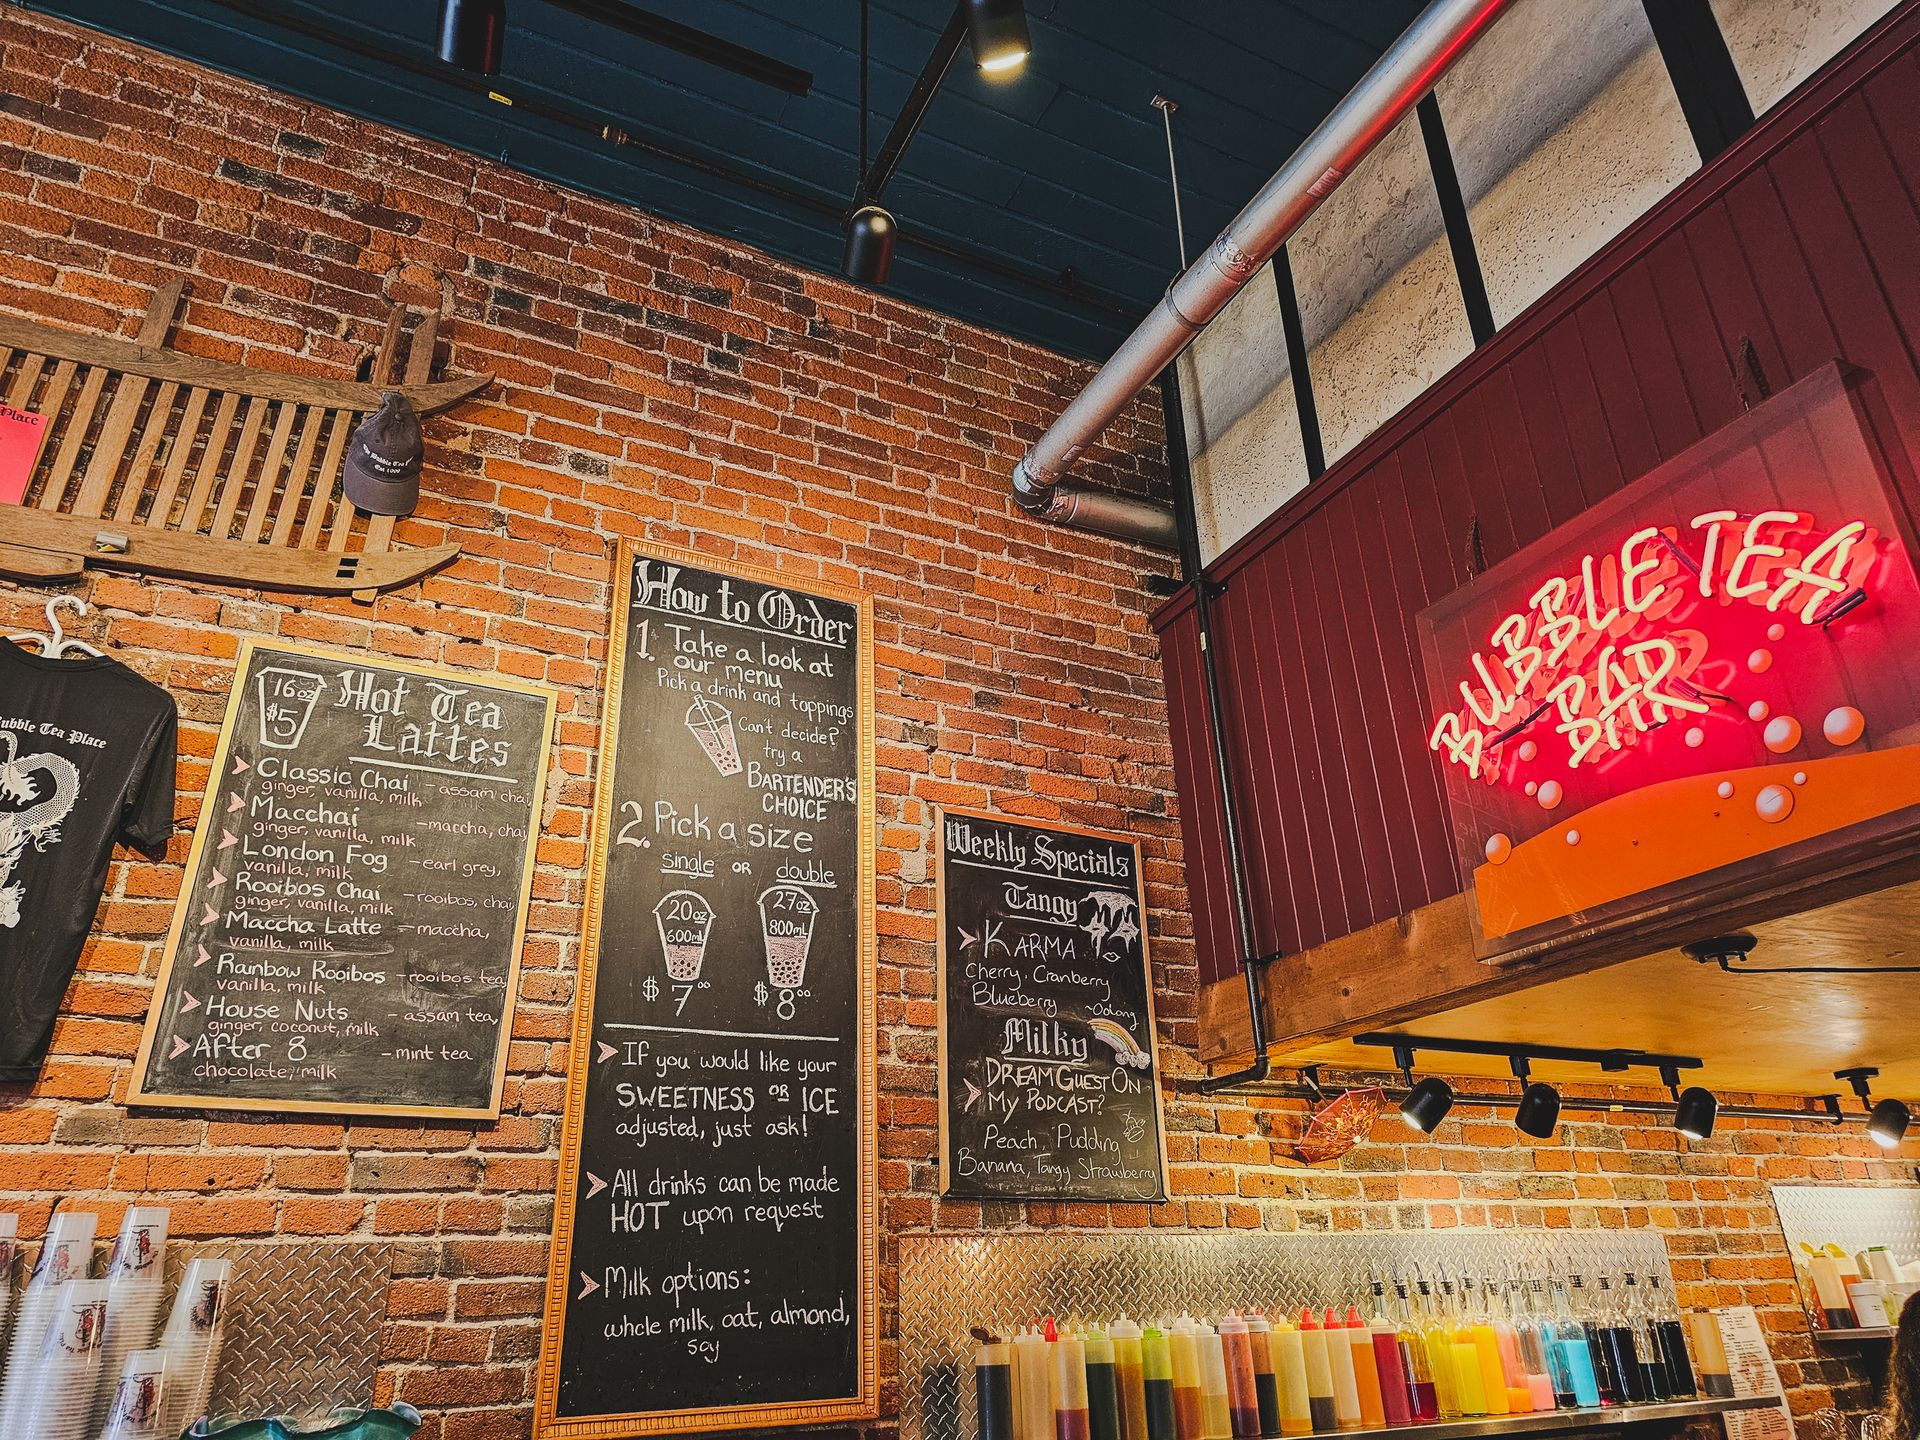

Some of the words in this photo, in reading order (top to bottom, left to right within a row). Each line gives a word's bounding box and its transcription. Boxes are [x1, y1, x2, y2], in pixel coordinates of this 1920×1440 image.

[632, 560, 710, 614] How
[717, 580, 751, 624] to
[758, 590, 853, 644] Order
[636, 619, 655, 662] 1.
[664, 623, 728, 659] Take
[735, 647, 754, 665] a
[761, 641, 805, 673] look
[808, 653, 834, 678] at
[1430, 527, 1664, 779] BUBBLE
[1691, 510, 1866, 625] TEA
[673, 655, 715, 675] our
[726, 664, 783, 690] menu
[334, 670, 411, 717] Hot
[425, 682, 503, 730] Tea
[658, 667, 687, 691] Pick
[691, 679, 703, 693] a
[708, 678, 747, 701] drink
[753, 690, 781, 708] and
[789, 693, 854, 725] toppings
[1547, 638, 1709, 768] BAR
[40, 723, 65, 738] Tea
[67, 730, 107, 748] Place
[266, 703, 299, 736] $5
[739, 716, 773, 734] Can't
[781, 722, 839, 746] decide?
[363, 714, 512, 767] Lattes
[763, 740, 785, 767] try
[791, 750, 803, 763] a
[257, 757, 352, 785] Classic
[360, 769, 409, 792] Chai
[748, 761, 857, 801] BARTENDER'S
[262, 780, 315, 799] ginger,
[325, 787, 384, 805] vanilla,
[389, 792, 422, 807] milk
[762, 793, 828, 822] CHOICE
[251, 795, 360, 828] Macchai
[616, 800, 651, 848] 2.
[655, 800, 711, 840] Pick
[718, 822, 738, 842] a
[252, 821, 309, 840] ginger,
[315, 828, 374, 845] vanilla,
[381, 833, 416, 847] milk
[945, 820, 1026, 871] Weekly
[1031, 835, 1129, 878] Specials
[243, 834, 334, 864] London
[346, 845, 388, 873] Fog
[244, 860, 309, 878] vanilla,
[316, 866, 353, 880] milk
[462, 863, 501, 877] grey,
[661, 851, 715, 879] single
[732, 860, 752, 875] OR
[776, 857, 836, 885] double
[235, 871, 326, 897] Rooibos
[337, 882, 381, 901] Chai
[235, 894, 290, 912] ginger,
[297, 899, 354, 915] vanilla,
[359, 902, 394, 916] milk
[1002, 881, 1078, 925] Tangy
[225, 911, 315, 933] Maccha
[325, 916, 382, 935] Latte
[229, 934, 291, 951] vanilla,
[299, 936, 334, 951] milk
[984, 919, 1076, 961] KARMA
[217, 952, 300, 978] Rainbow
[312, 960, 386, 984] Rooibos
[479, 969, 507, 988] tea,
[1033, 964, 1110, 1001] Cranberry
[216, 978, 281, 993] vanilla,
[288, 981, 326, 995] milk
[972, 981, 1057, 1017] Blueberry
[205, 994, 281, 1019] House
[295, 999, 349, 1021] Nuts
[465, 1008, 499, 1025] tea,
[207, 1018, 263, 1037] ginger,
[271, 1021, 340, 1038] coconut,
[346, 1021, 379, 1036] milk
[1001, 1018, 1088, 1062] Milky
[192, 1033, 271, 1059] After
[287, 1036, 308, 1061] 8
[440, 1045, 473, 1060] tea
[622, 1040, 650, 1066] If
[656, 1054, 690, 1078] you
[700, 1049, 749, 1072] would
[760, 1050, 790, 1072] like
[798, 1059, 837, 1080] your
[301, 1063, 337, 1080] milk
[986, 1057, 1054, 1088] DREAM
[1056, 1065, 1110, 1092] GUEST
[1111, 1066, 1141, 1094] ON
[615, 1082, 754, 1112] SWEETNESS
[768, 1084, 790, 1102] OR
[802, 1086, 840, 1115] ICE
[1027, 1087, 1105, 1116] PODCAST?
[615, 1114, 705, 1148] adjusted,
[713, 1115, 752, 1148] just
[765, 1114, 808, 1138] ask!
[1057, 1123, 1120, 1165] Pudding
[612, 1168, 638, 1198] All
[648, 1168, 707, 1196] drinks
[719, 1176, 751, 1193] can
[758, 1165, 781, 1193] be
[789, 1165, 840, 1193] made
[957, 1147, 1031, 1179] Banana,
[1033, 1153, 1071, 1185] Tangy
[1078, 1157, 1158, 1199] Strawberry
[611, 1200, 670, 1233] HOT
[683, 1206, 734, 1235] upon
[745, 1196, 824, 1232] request
[605, 1266, 652, 1299] Milk
[662, 1261, 751, 1308] options:
[604, 1315, 662, 1338] whole
[670, 1308, 714, 1333] milk,
[722, 1301, 762, 1329] oat,
[770, 1297, 850, 1326] almond,
[688, 1339, 720, 1363] soy
